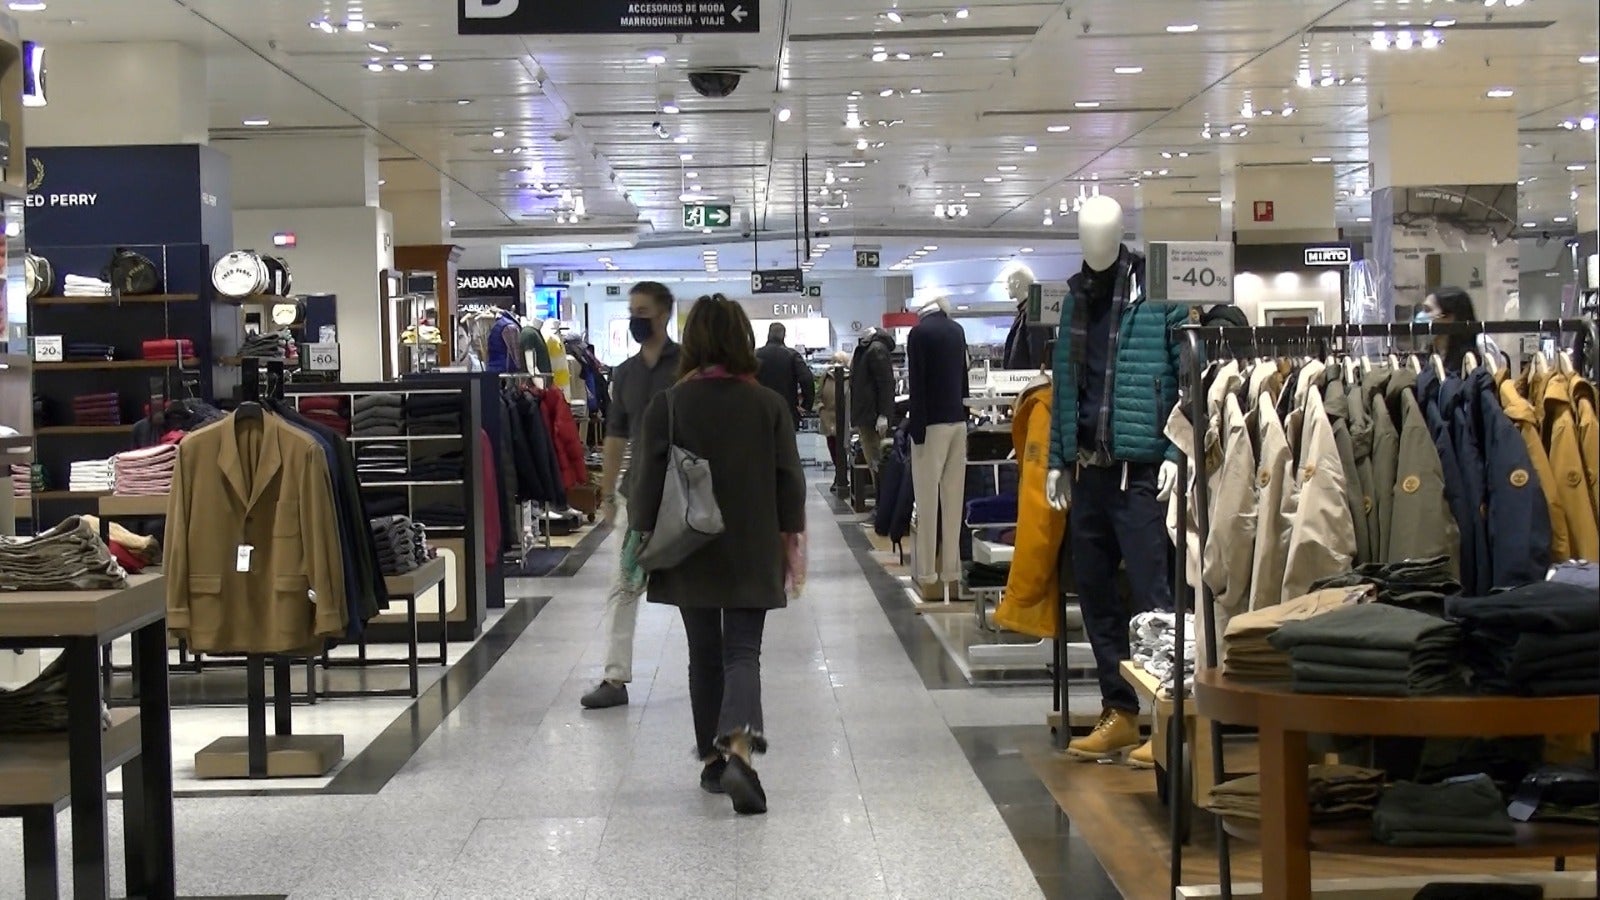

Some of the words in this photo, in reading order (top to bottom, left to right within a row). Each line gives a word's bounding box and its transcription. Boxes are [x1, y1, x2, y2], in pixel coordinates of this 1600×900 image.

[628, 3, 684, 13] ACCESORIOS
[685, 3, 697, 13] DE
[699, 3, 726, 13] MODA
[620, 14, 693, 26] MARROQUINERÍA
[700, 15, 725, 25] VIAJE
[25, 194, 45, 207] ED
[50, 193, 97, 207] PERRY
[1308, 250, 1347, 262] MIRTO
[752, 274, 762, 291] B
[1172, 267, 1228, 287] -40%
[773, 304, 813, 316] ETNIA
[1044, 301, 1060, 313] -4
